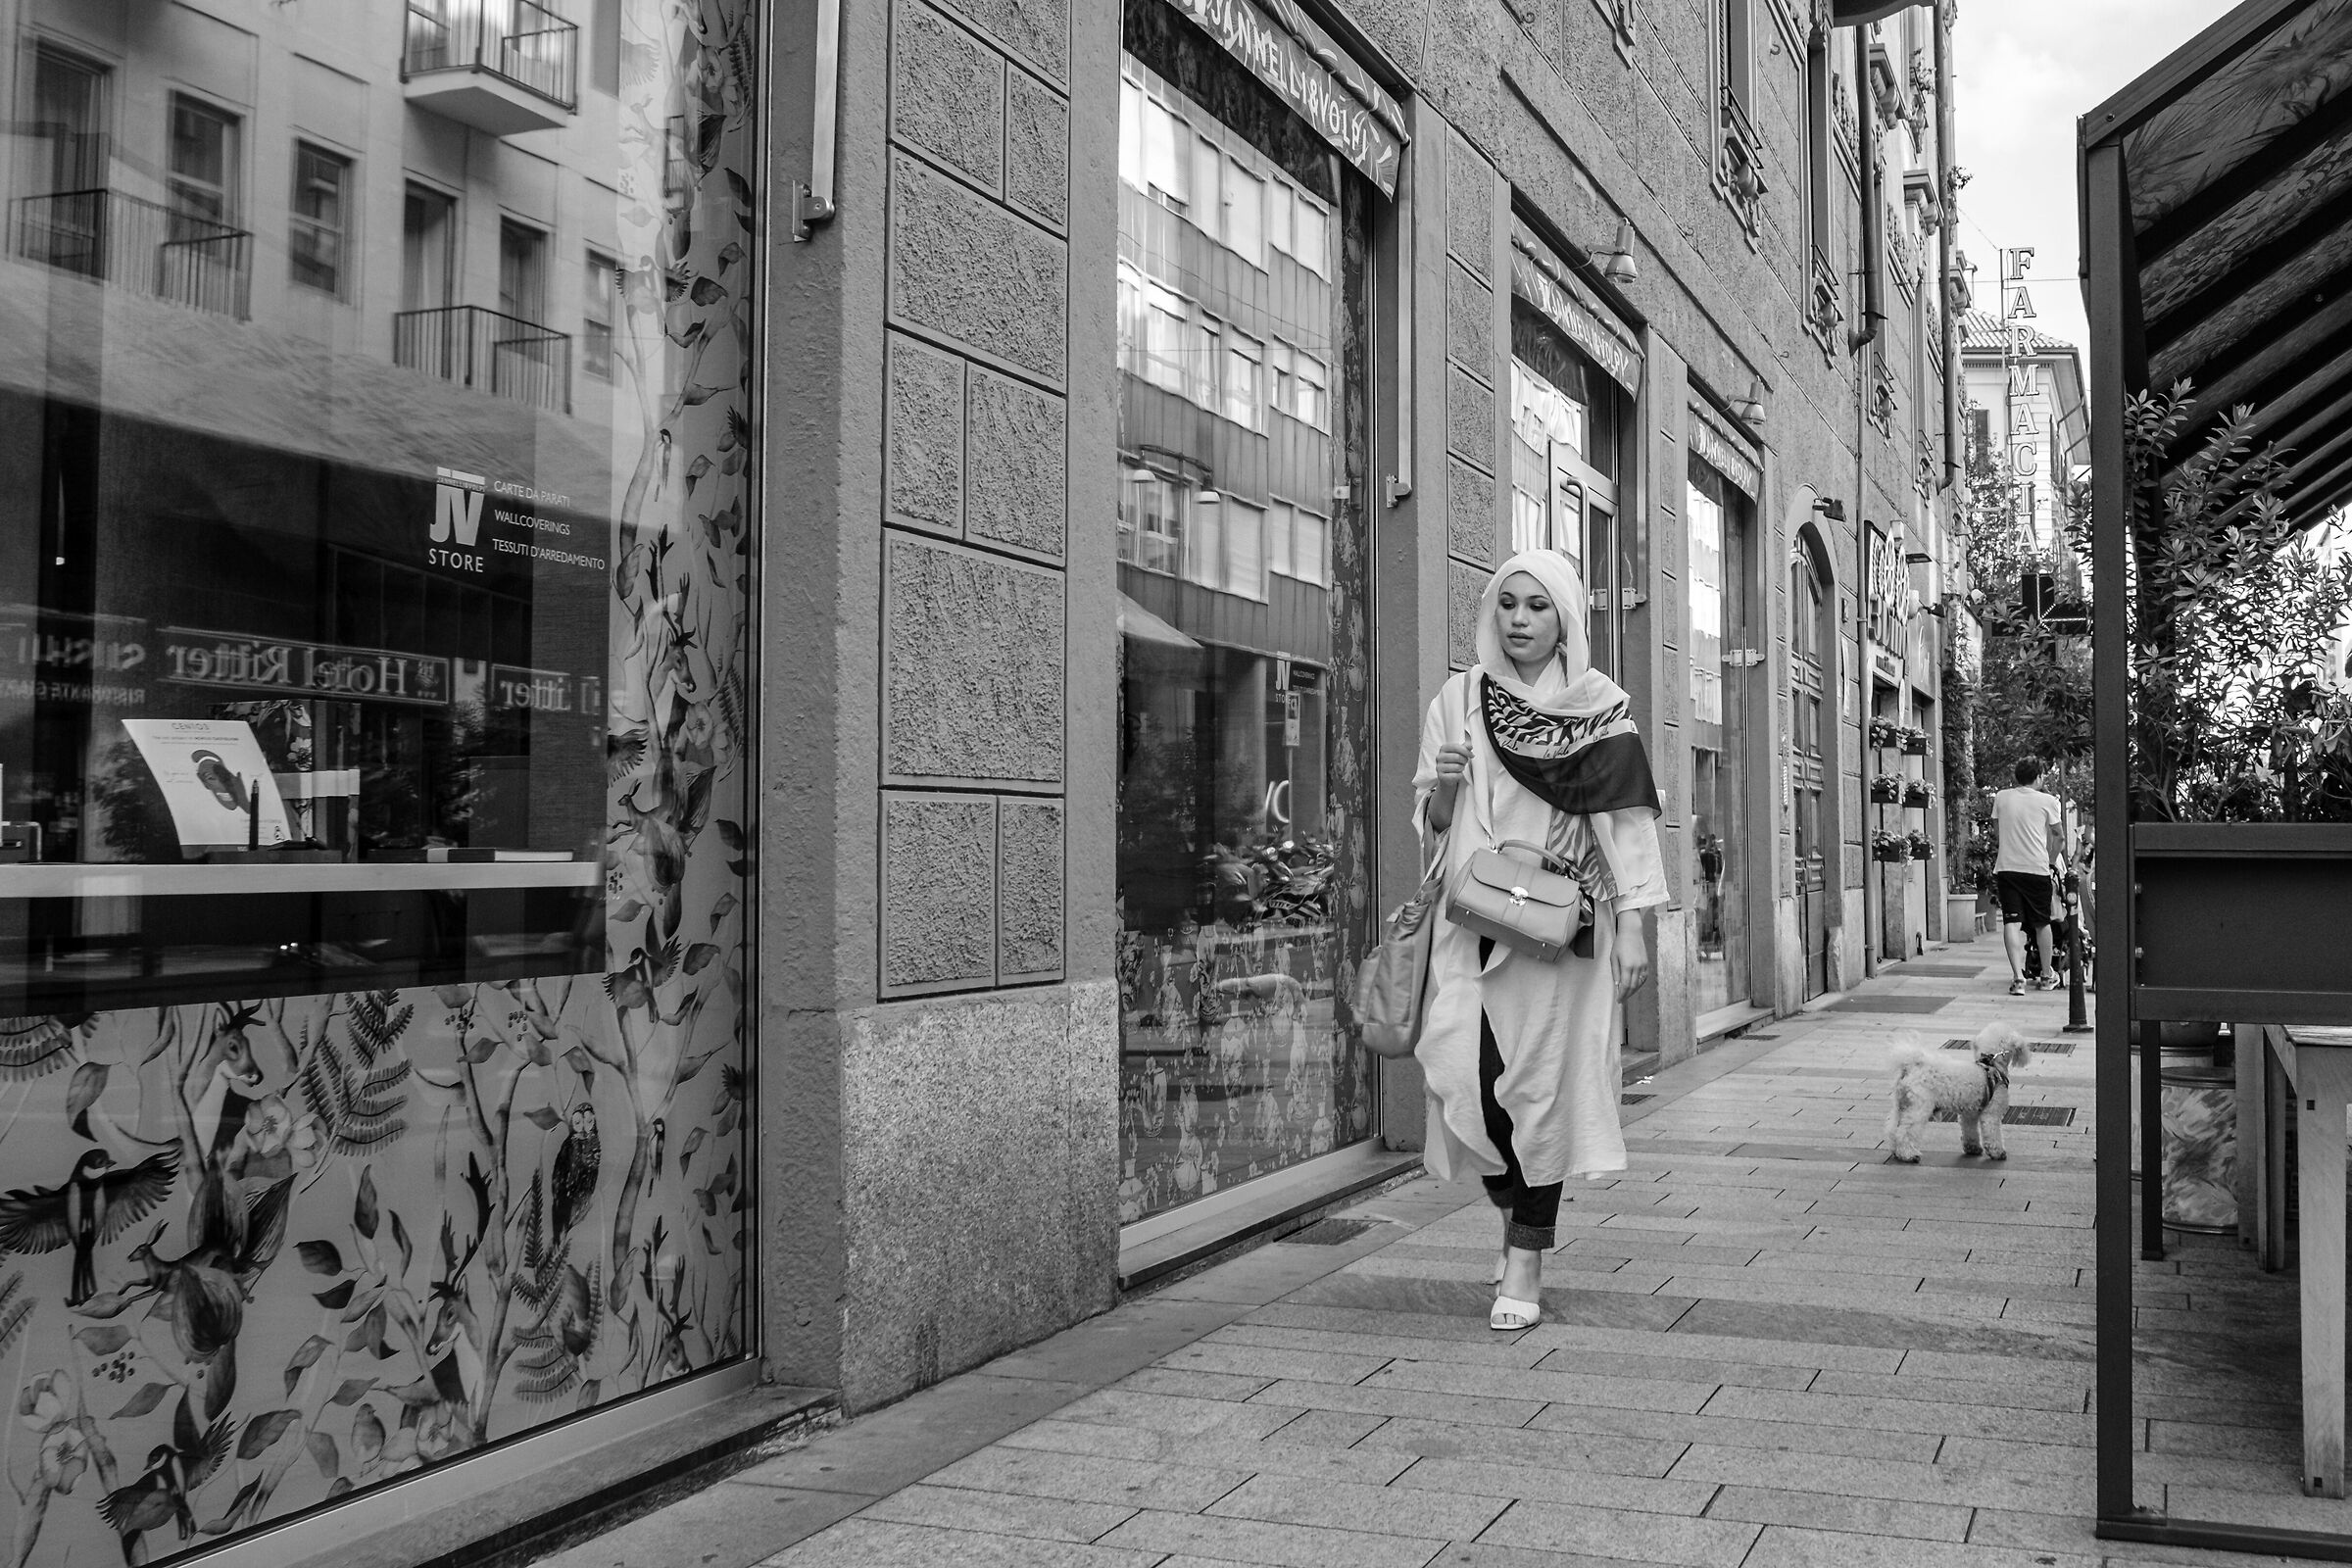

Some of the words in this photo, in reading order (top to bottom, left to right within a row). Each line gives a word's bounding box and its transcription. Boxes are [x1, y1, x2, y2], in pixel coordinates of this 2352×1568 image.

[2008, 246, 2042, 557] FARMACIA
[494, 480, 525, 498] CARTE
[525, 487, 539, 501] DA
[540, 490, 570, 508] PARATI
[494, 509, 570, 536] WALLCOVERINGS
[428, 548, 484, 573] STORE
[492, 538, 529, 557] TESSUTI
[530, 545, 606, 570] D'ARREDAMENTO
